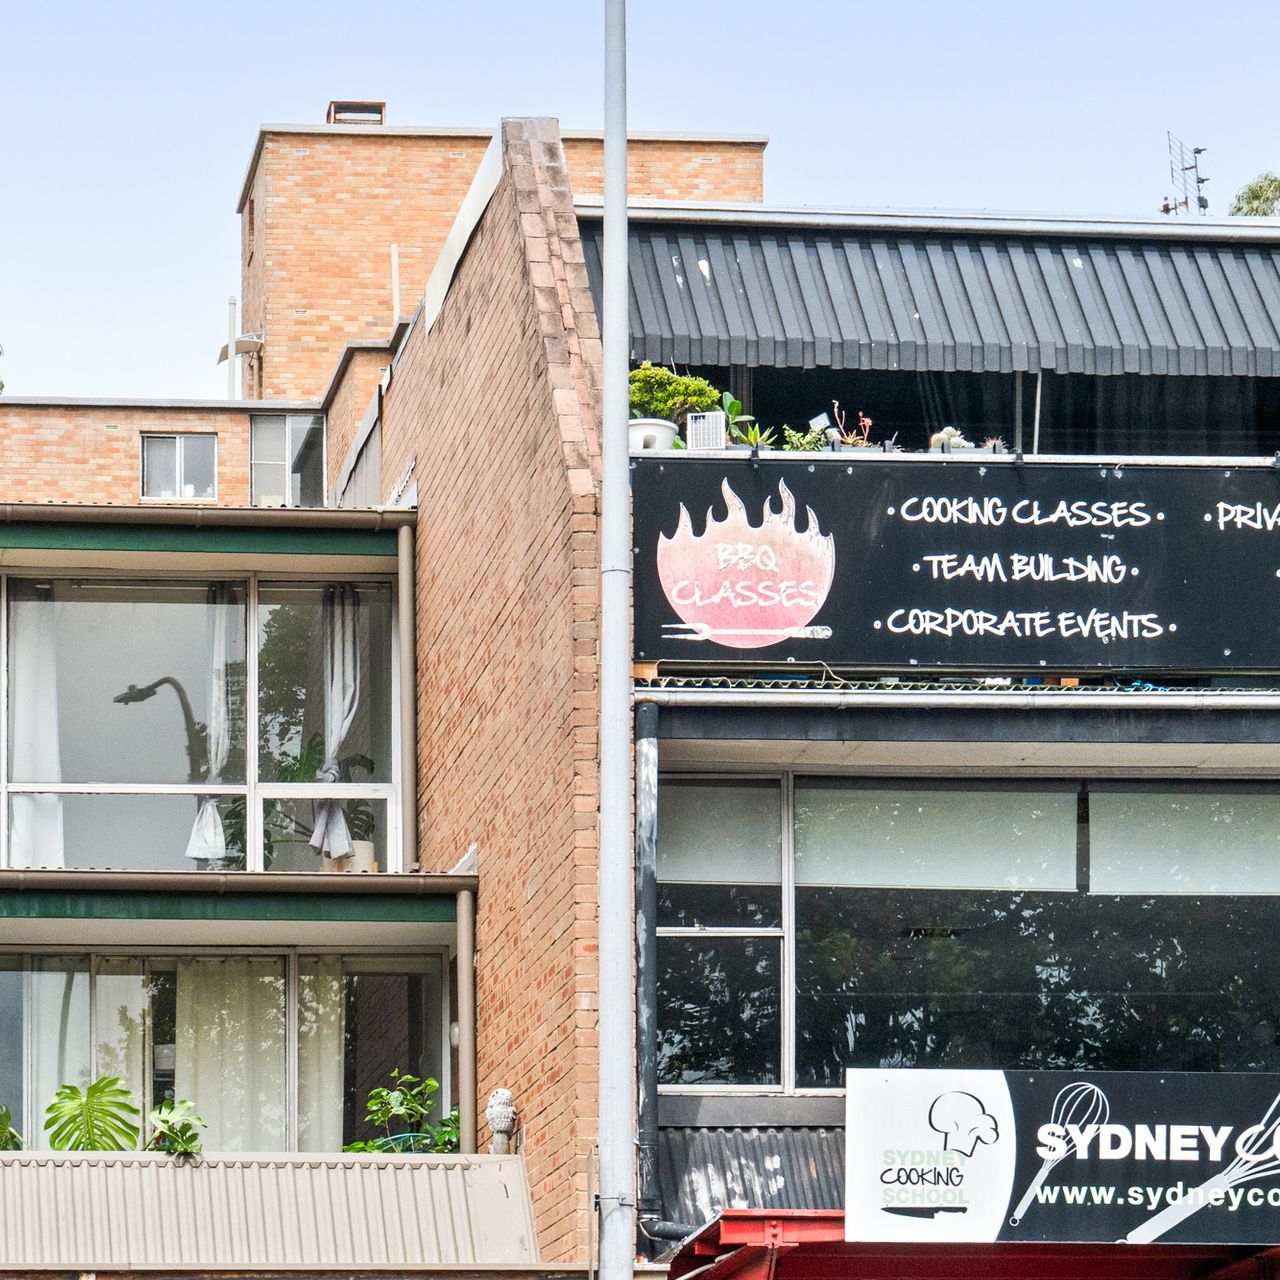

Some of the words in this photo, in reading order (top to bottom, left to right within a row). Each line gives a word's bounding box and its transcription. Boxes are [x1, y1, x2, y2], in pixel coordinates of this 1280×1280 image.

[901, 497, 1007, 526] COOKING
[1012, 499, 1151, 528] CLASSES
[715, 542, 779, 573] BBQ
[923, 553, 1007, 583] TEAM
[1011, 553, 1127, 584] BUILDING
[671, 580, 819, 608] CLASSES
[887, 608, 1056, 638] CORPORATE
[1059, 608, 1163, 640] EVENTS
[883, 1150, 967, 1166] SYDNEY
[1036, 1124, 1234, 1162] SYDNEY
[880, 1166, 964, 1187] COOKING
[883, 1187, 969, 1205] SCHOOL
